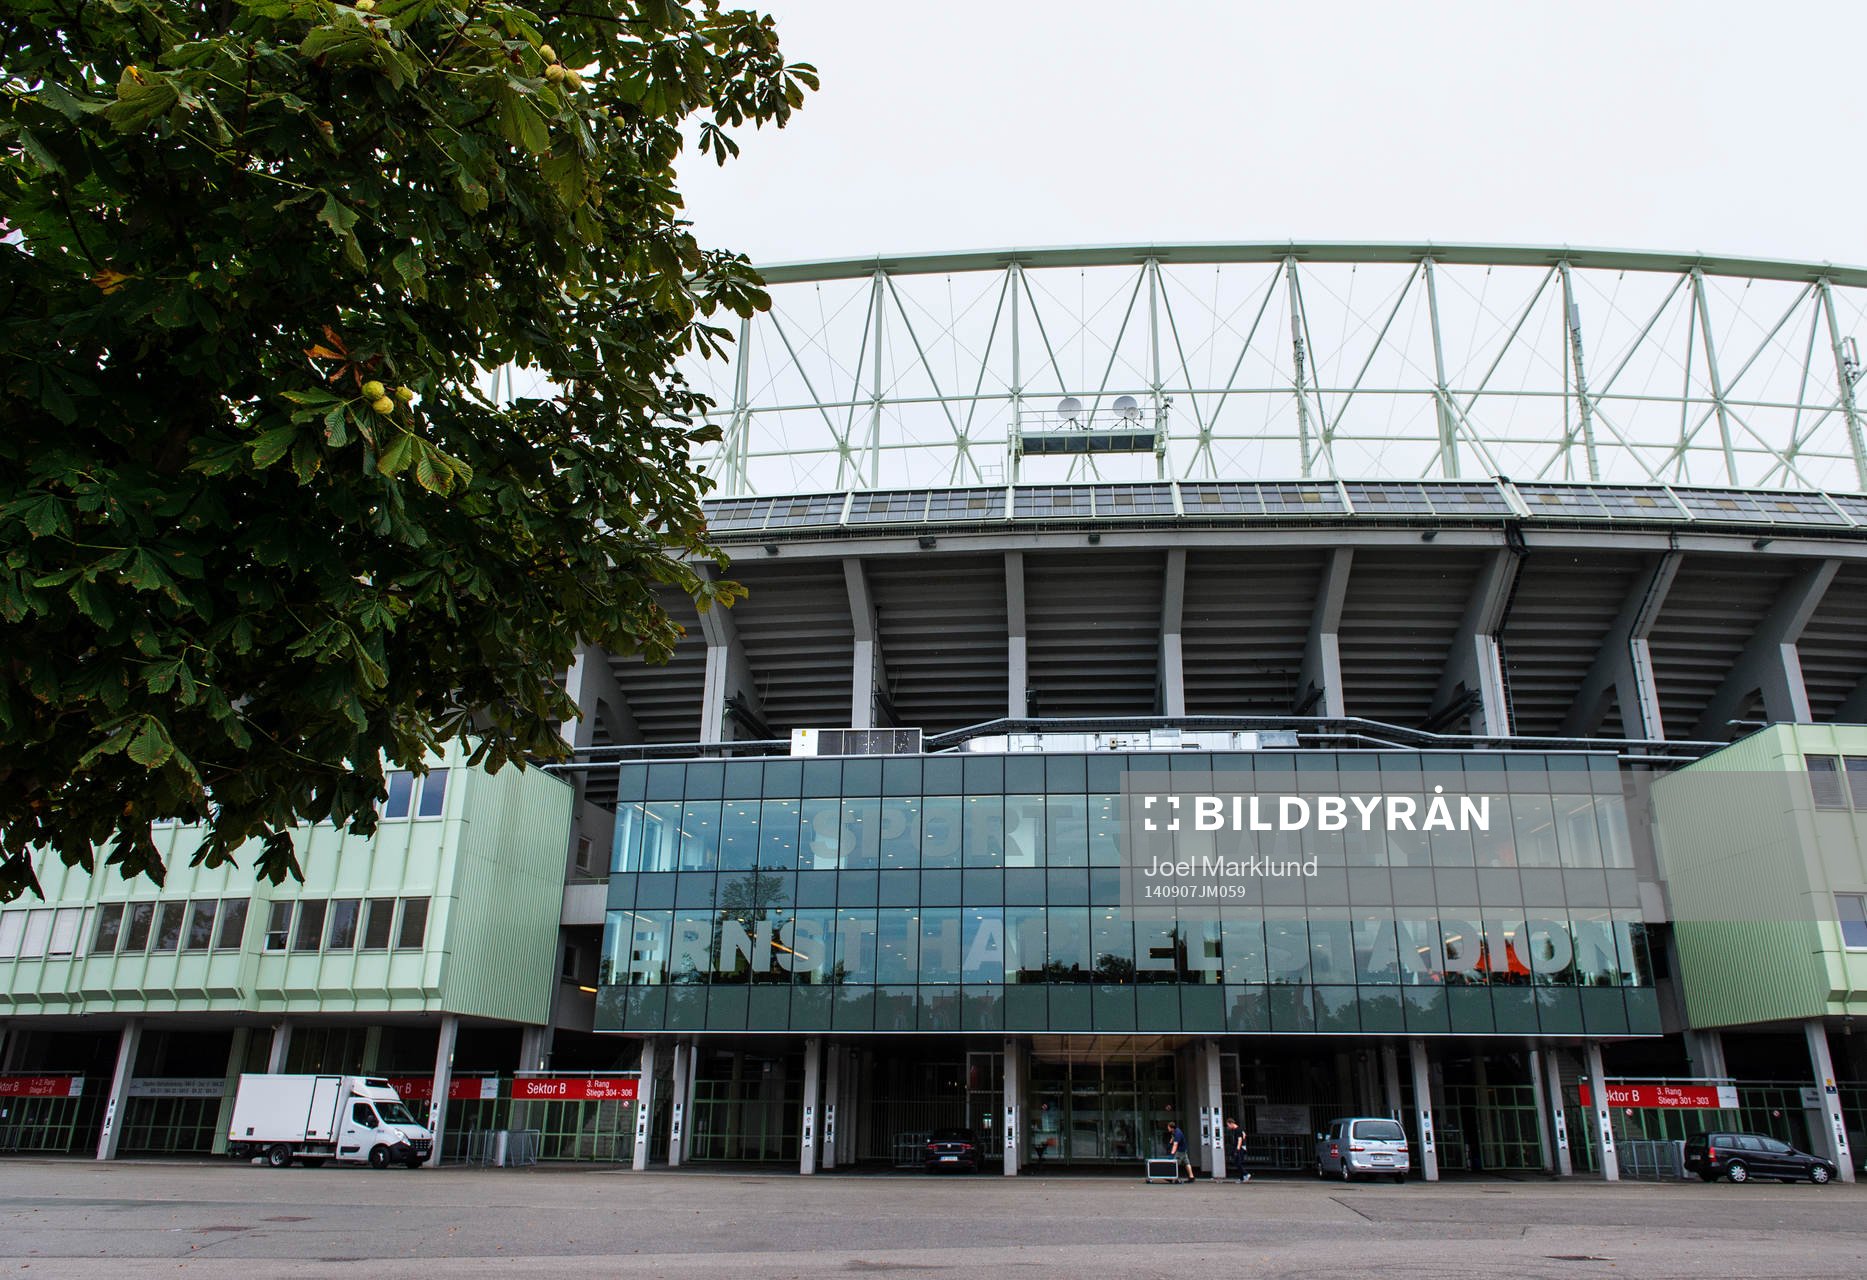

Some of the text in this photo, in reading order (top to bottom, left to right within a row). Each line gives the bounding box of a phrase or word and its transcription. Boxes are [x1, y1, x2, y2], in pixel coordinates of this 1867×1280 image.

[809, 804, 1073, 858] SPORT
[614, 917, 877, 973] ERNST
[1257, 918, 1636, 975] STADION
[526, 1082, 567, 1095] Sektor B
[594, 1080, 610, 1089] Rang
[586, 1088, 605, 1097] Stiege
[605, 1088, 617, 1097] 304
[1606, 1089, 1640, 1102] ektor B
[1656, 1087, 1682, 1096] 3. Rang
[1658, 1096, 1679, 1106] Stiege
[1680, 1096, 1692, 1105] 301
